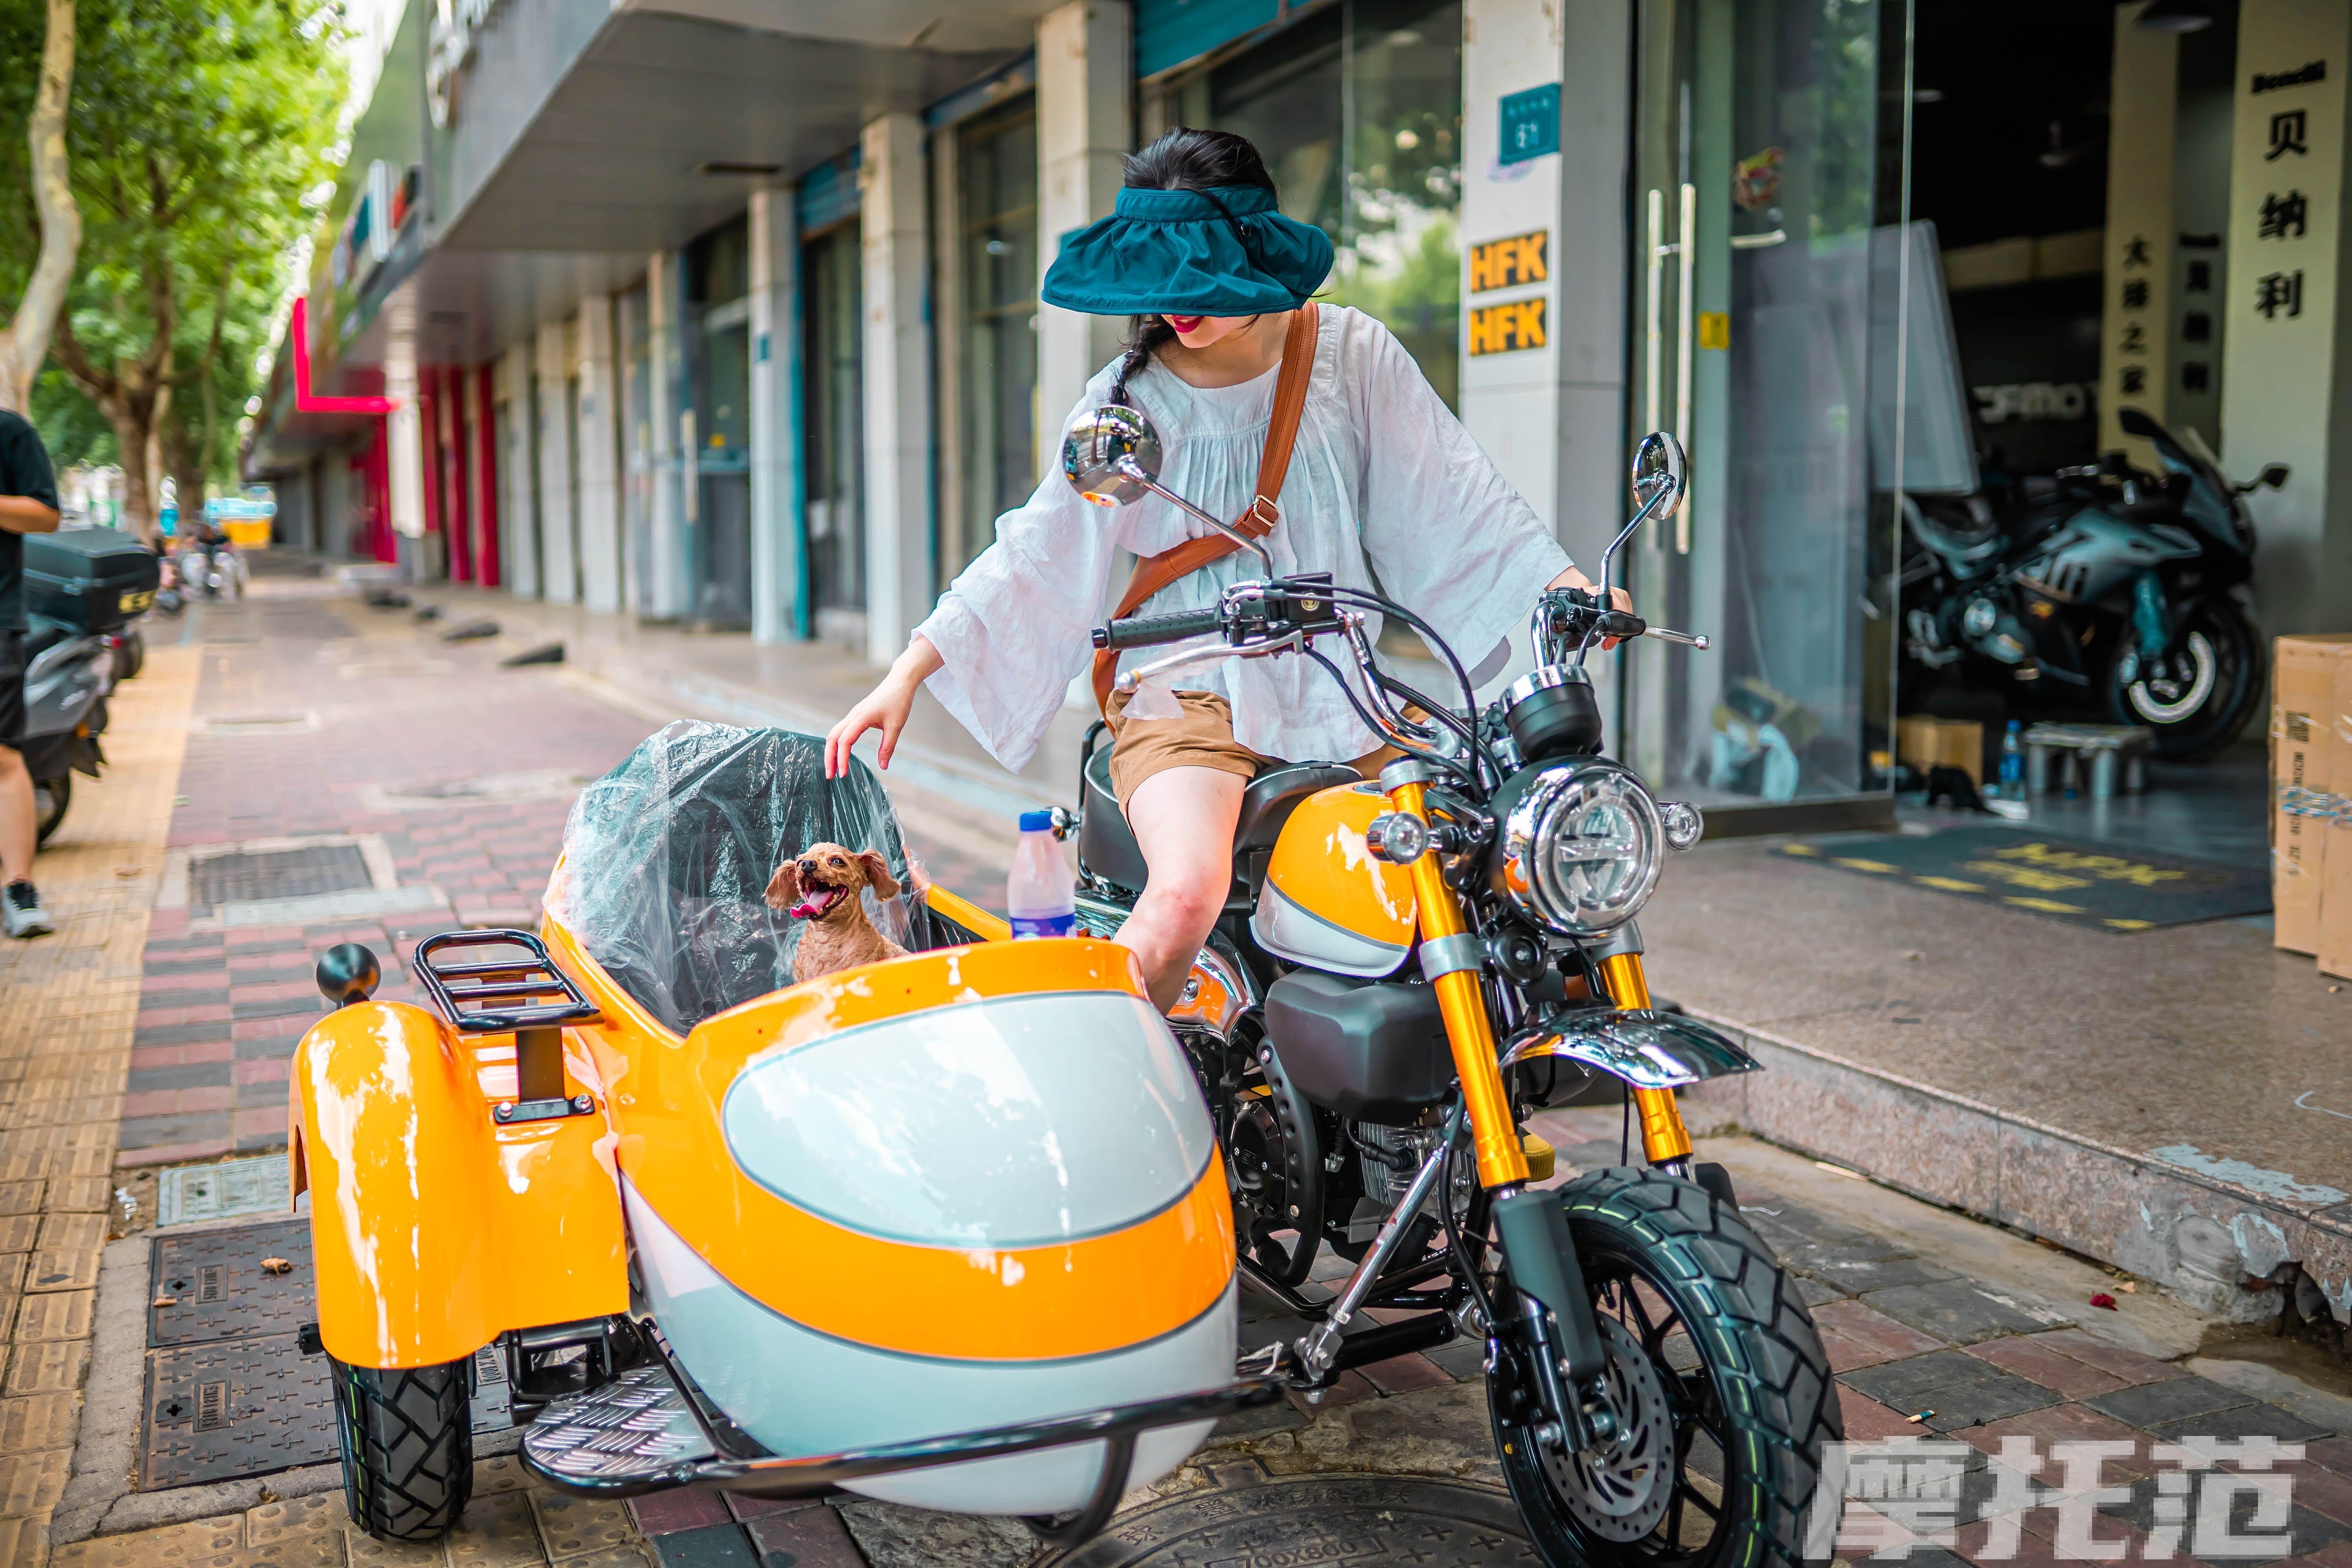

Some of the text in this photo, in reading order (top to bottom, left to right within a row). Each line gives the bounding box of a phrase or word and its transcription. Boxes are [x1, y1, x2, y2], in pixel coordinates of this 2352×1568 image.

[2257, 111, 2307, 318] 贝纳利
[1471, 230, 1547, 292] HFK
[1470, 298, 1546, 356] HFK
